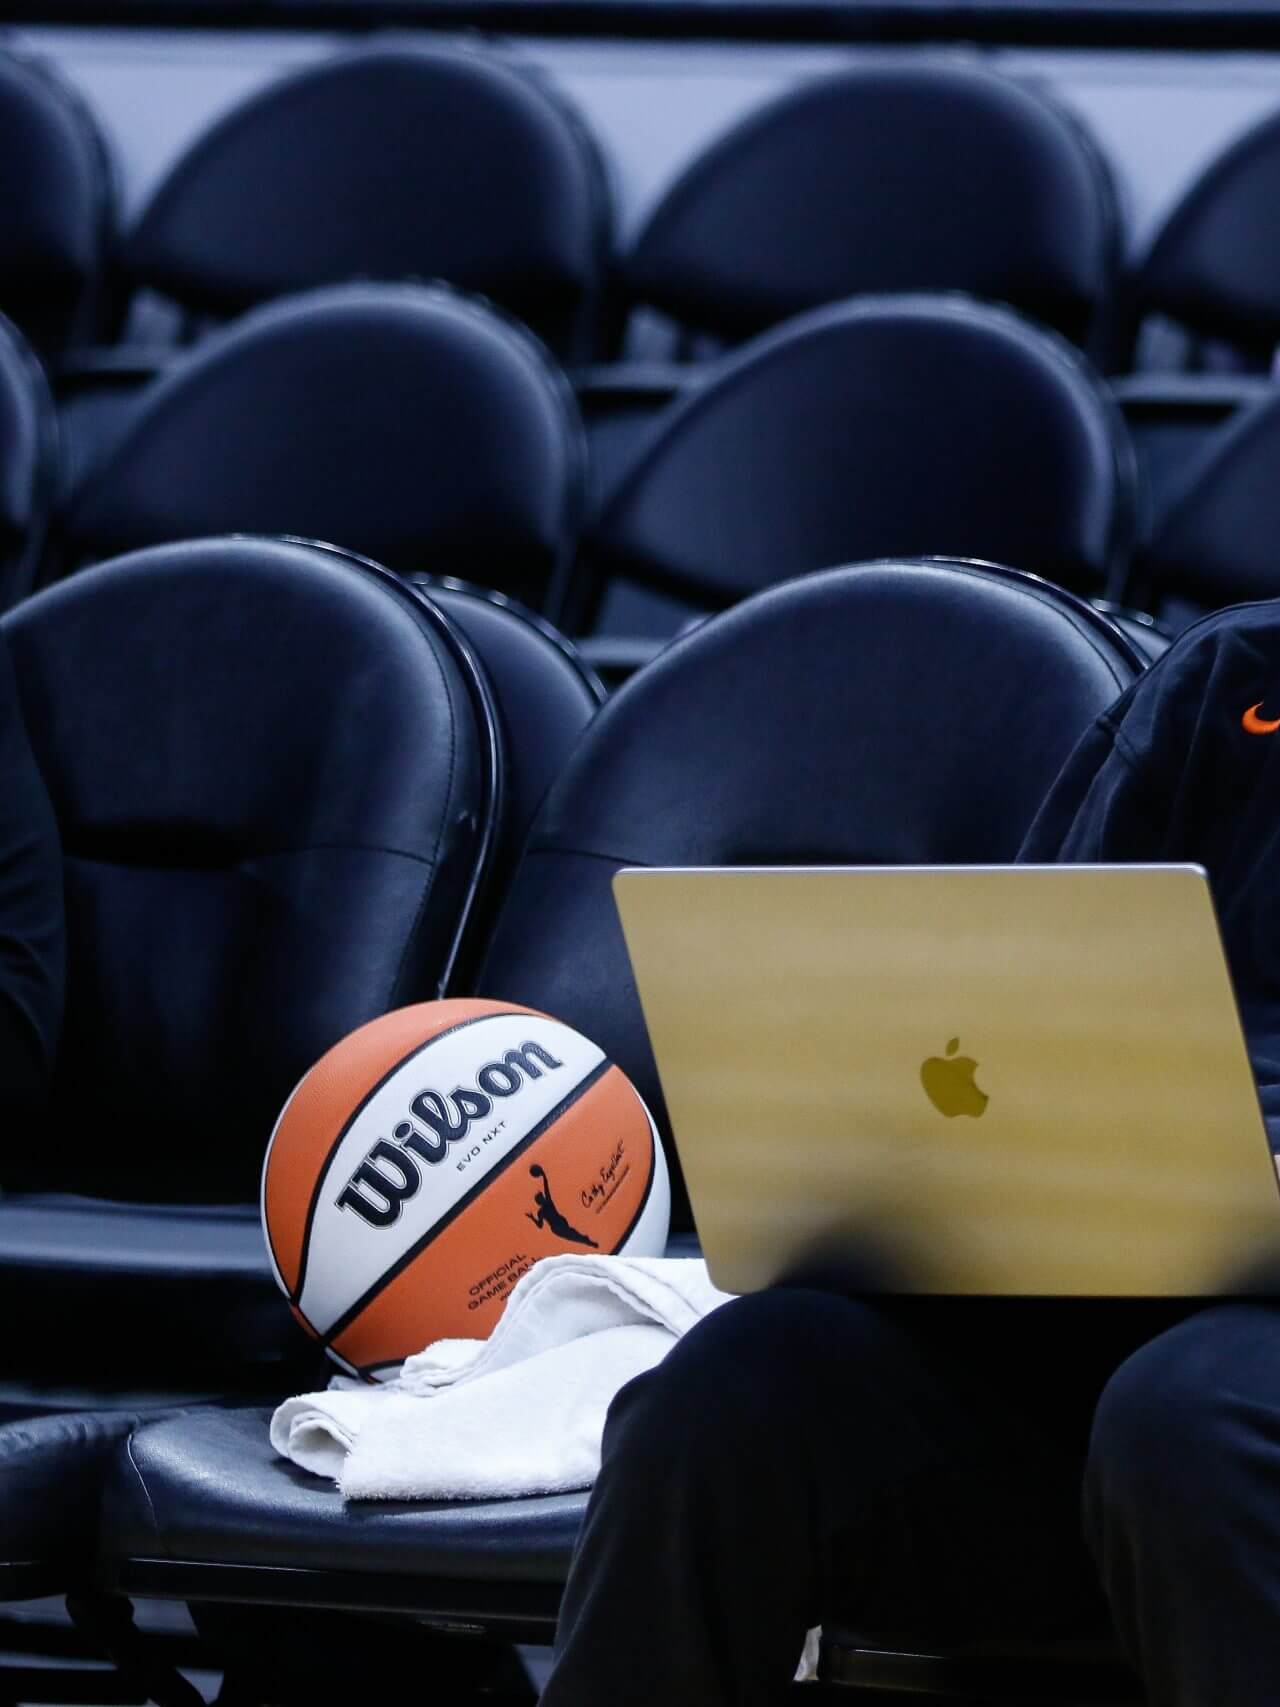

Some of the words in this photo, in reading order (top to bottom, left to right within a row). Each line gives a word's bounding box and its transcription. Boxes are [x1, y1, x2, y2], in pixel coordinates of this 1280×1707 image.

[334, 1040, 562, 1230] Wilson
[456, 1145, 481, 1172] EVO
[482, 1120, 507, 1145] NXT
[468, 1280, 506, 1311] GAME
[469, 1253, 527, 1296] OFFICIAL
